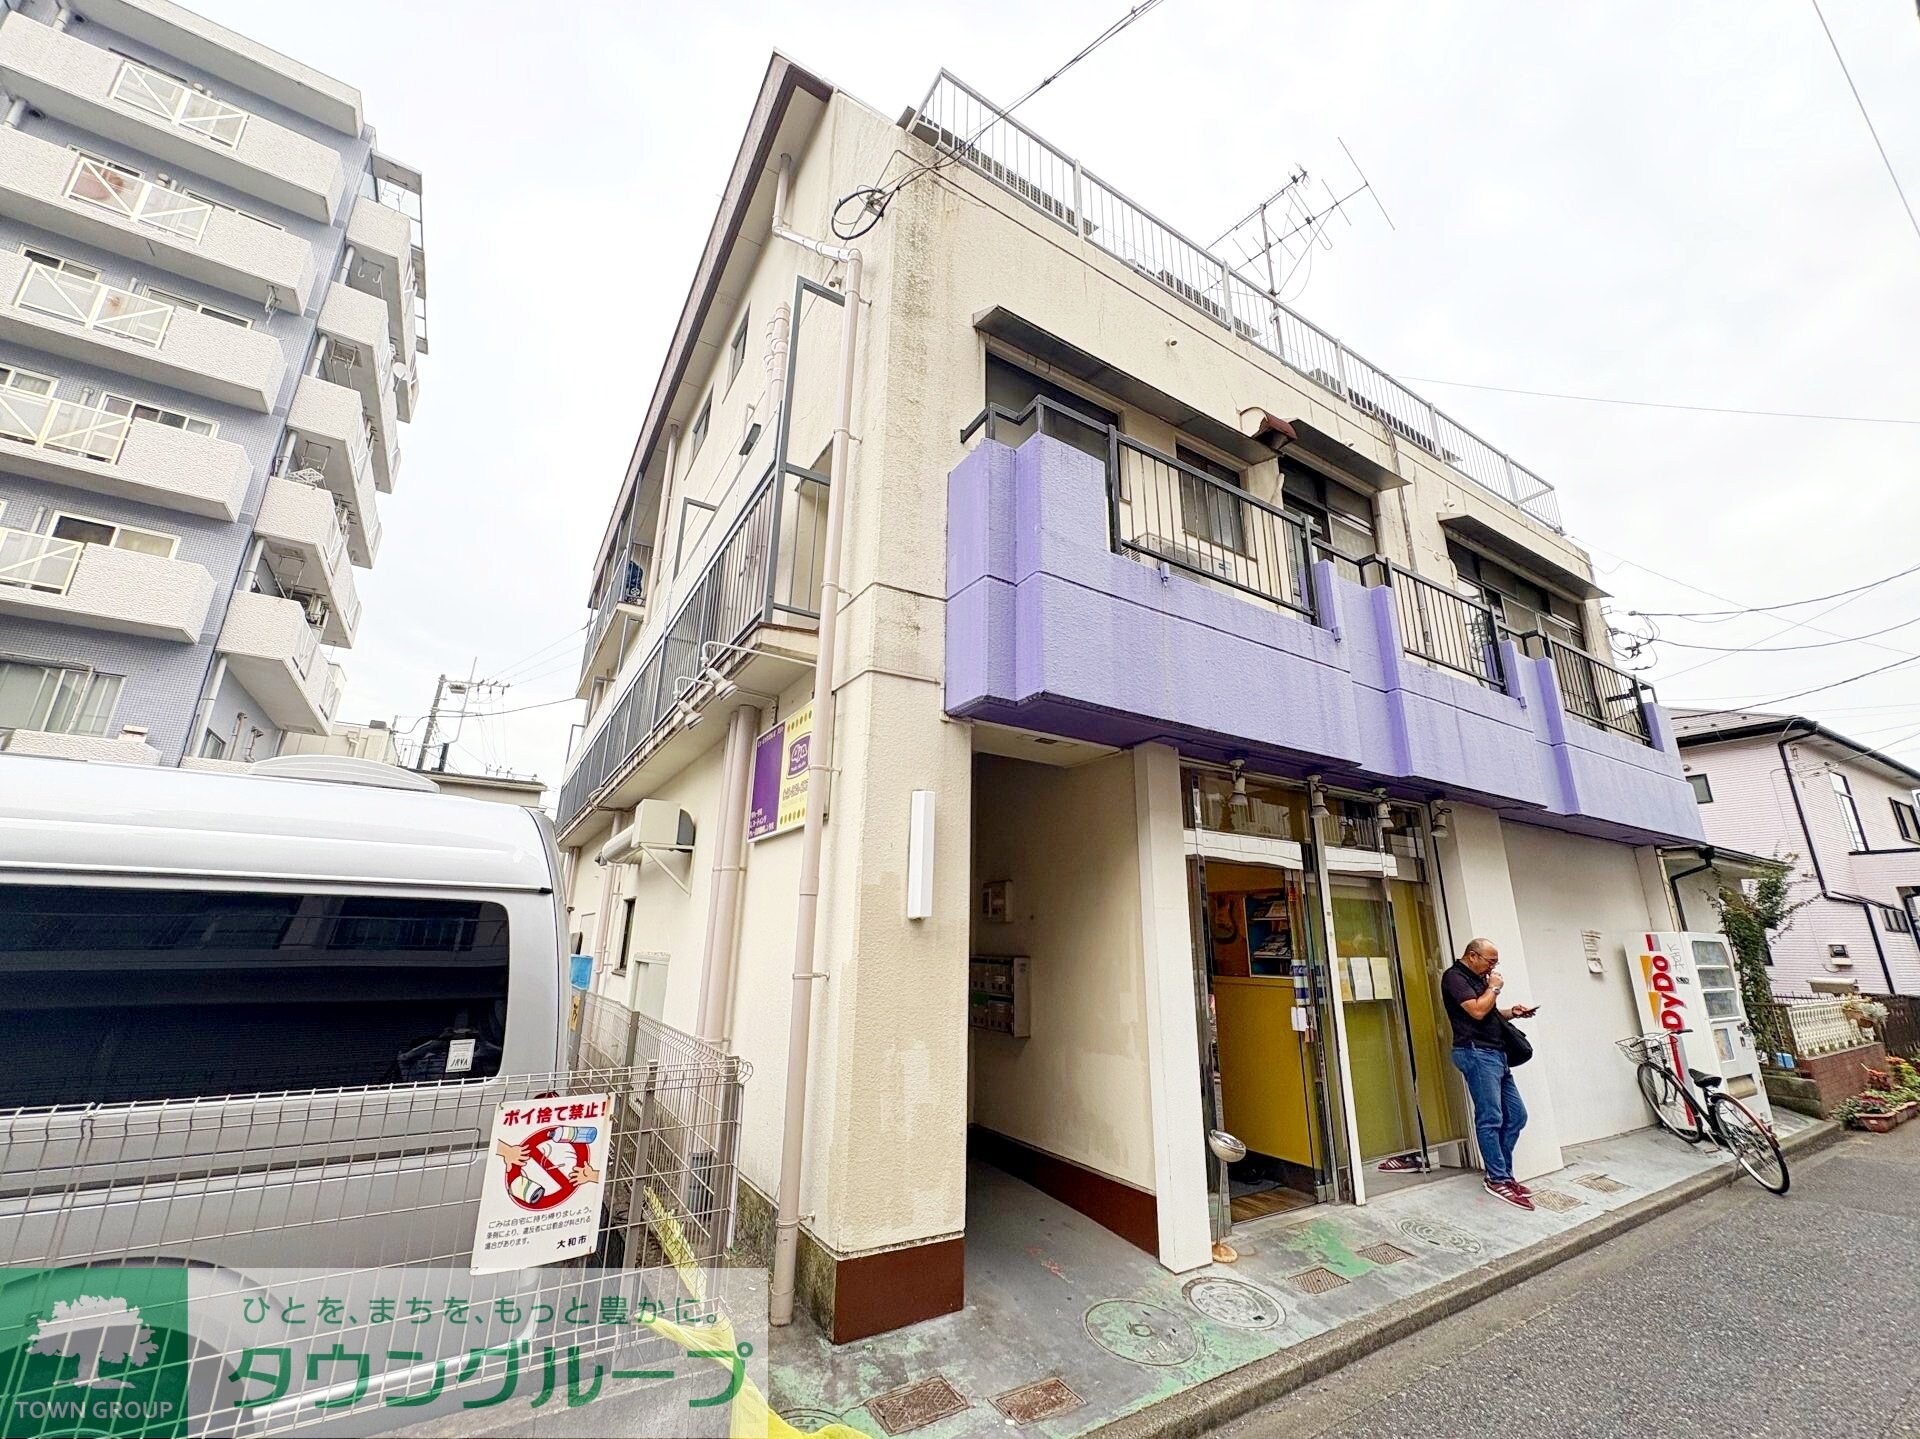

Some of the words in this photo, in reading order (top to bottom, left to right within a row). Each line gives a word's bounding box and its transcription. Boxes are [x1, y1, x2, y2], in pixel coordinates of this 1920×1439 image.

[1652, 955, 1686, 1031] DyDo
[556, 1235, 587, 1249] 大和市
